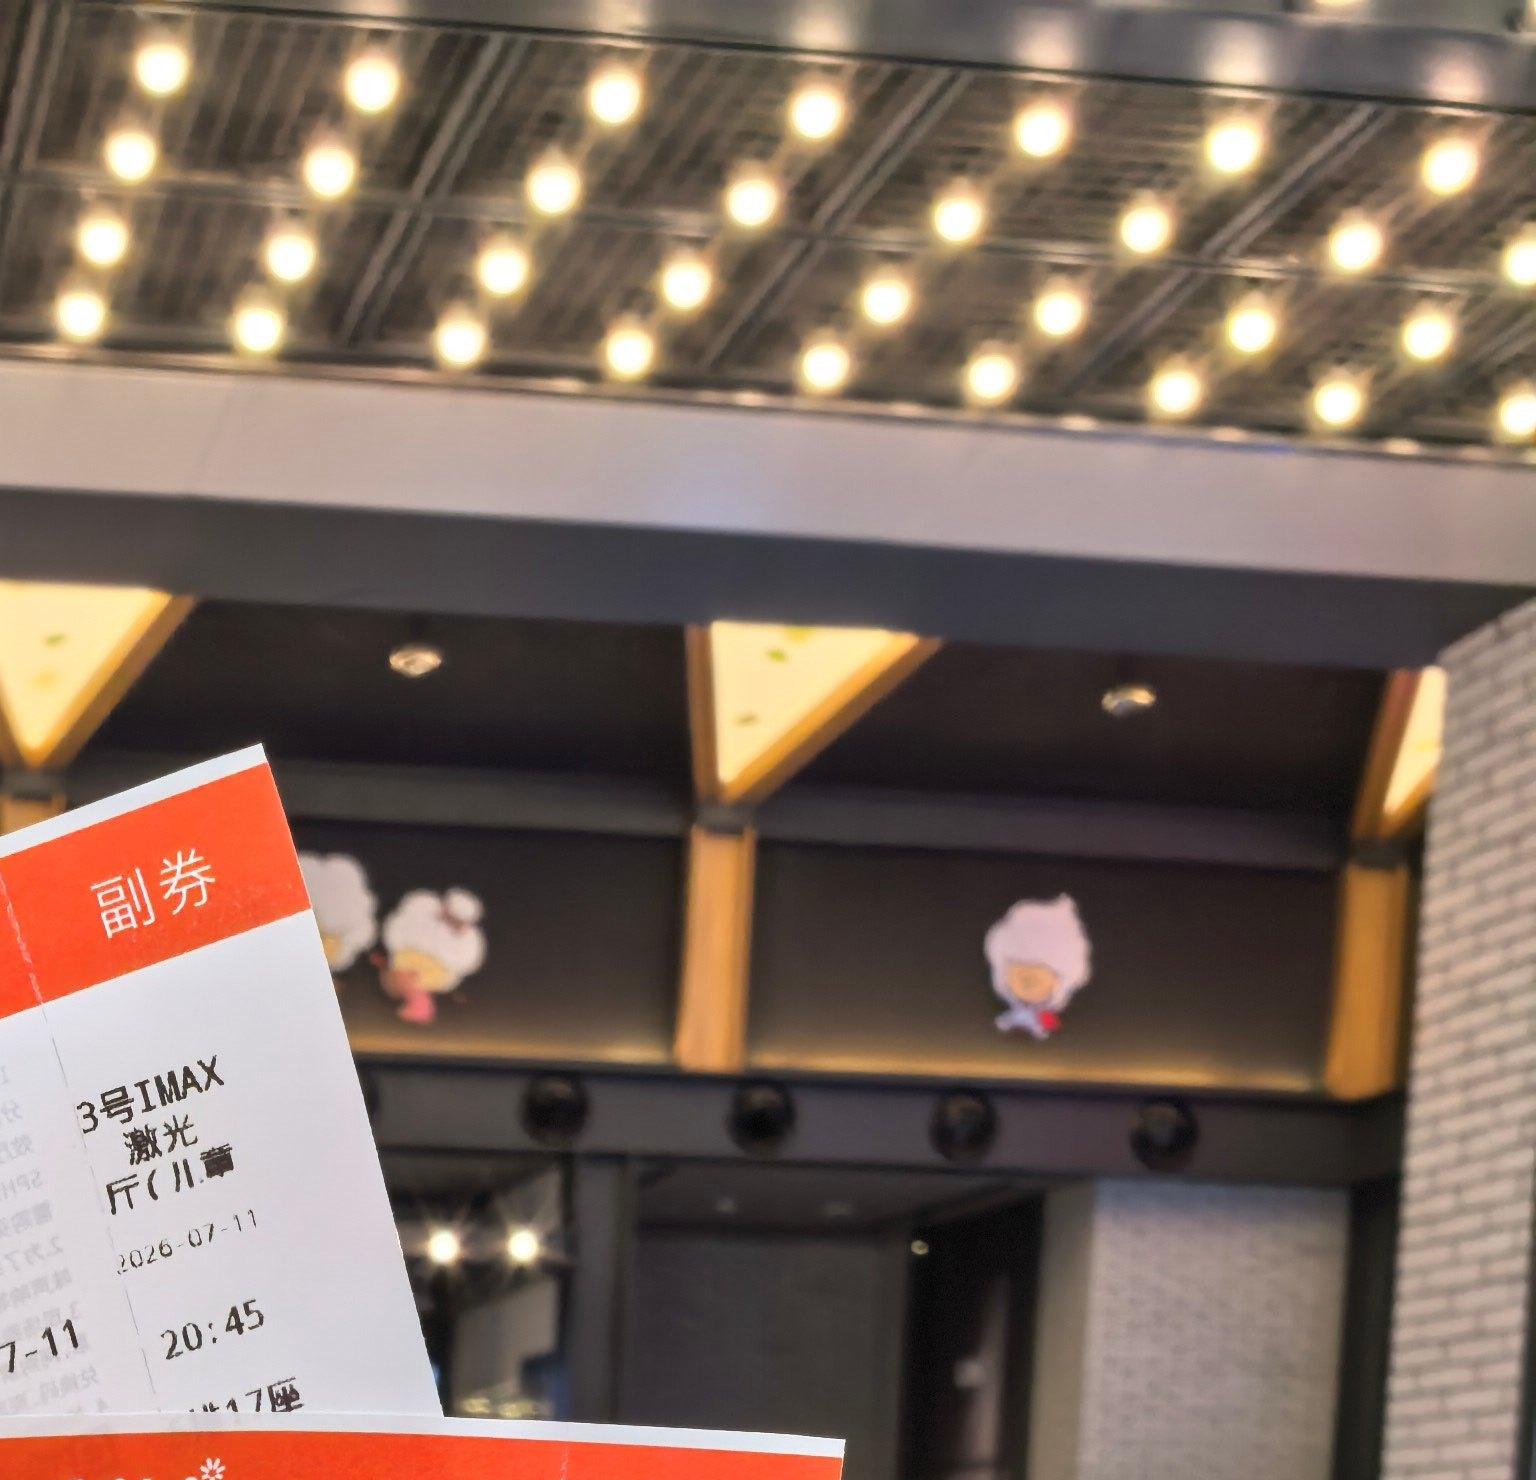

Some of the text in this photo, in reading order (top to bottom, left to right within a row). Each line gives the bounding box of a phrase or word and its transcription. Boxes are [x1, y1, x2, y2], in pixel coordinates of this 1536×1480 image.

[90, 848, 215, 939] 副券
[76, 1054, 225, 1134] 3号IMAX
[122, 1114, 199, 1166] 激光
[116, 1209, 257, 1276] 2026-07-11
[160, 1298, 265, 1360] 20:45
